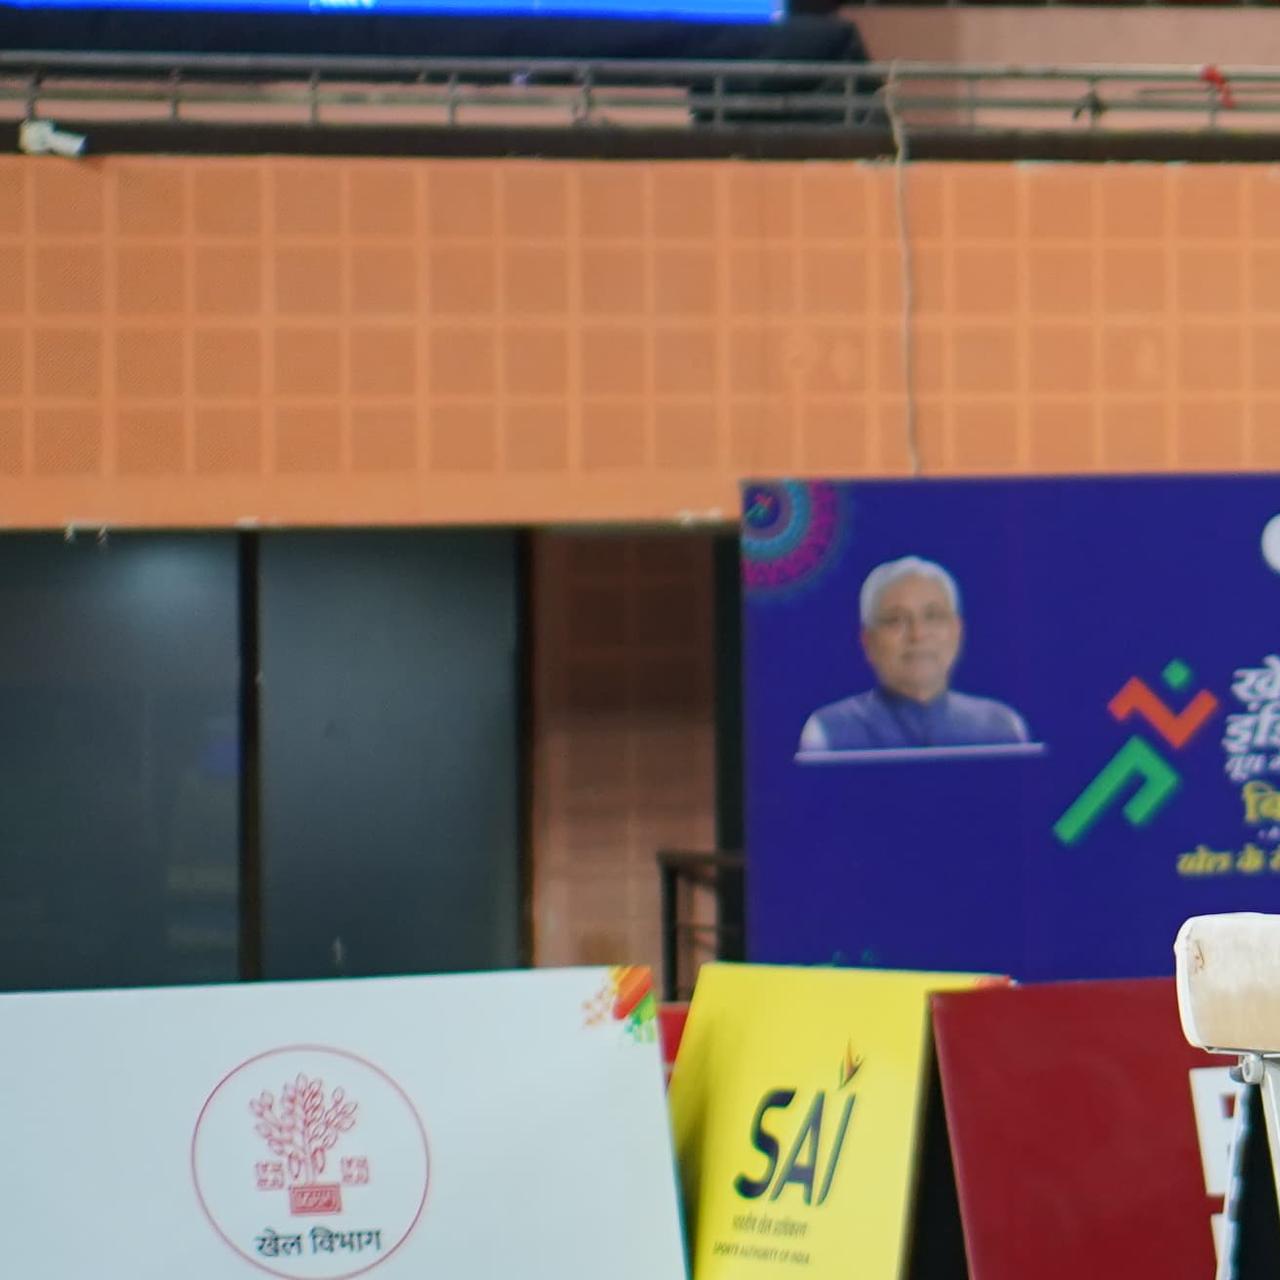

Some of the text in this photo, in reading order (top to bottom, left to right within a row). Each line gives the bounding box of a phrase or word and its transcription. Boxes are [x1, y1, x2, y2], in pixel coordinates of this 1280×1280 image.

[733, 1086, 858, 1207] SAI
[254, 1225, 382, 1257] खेल विभाग
